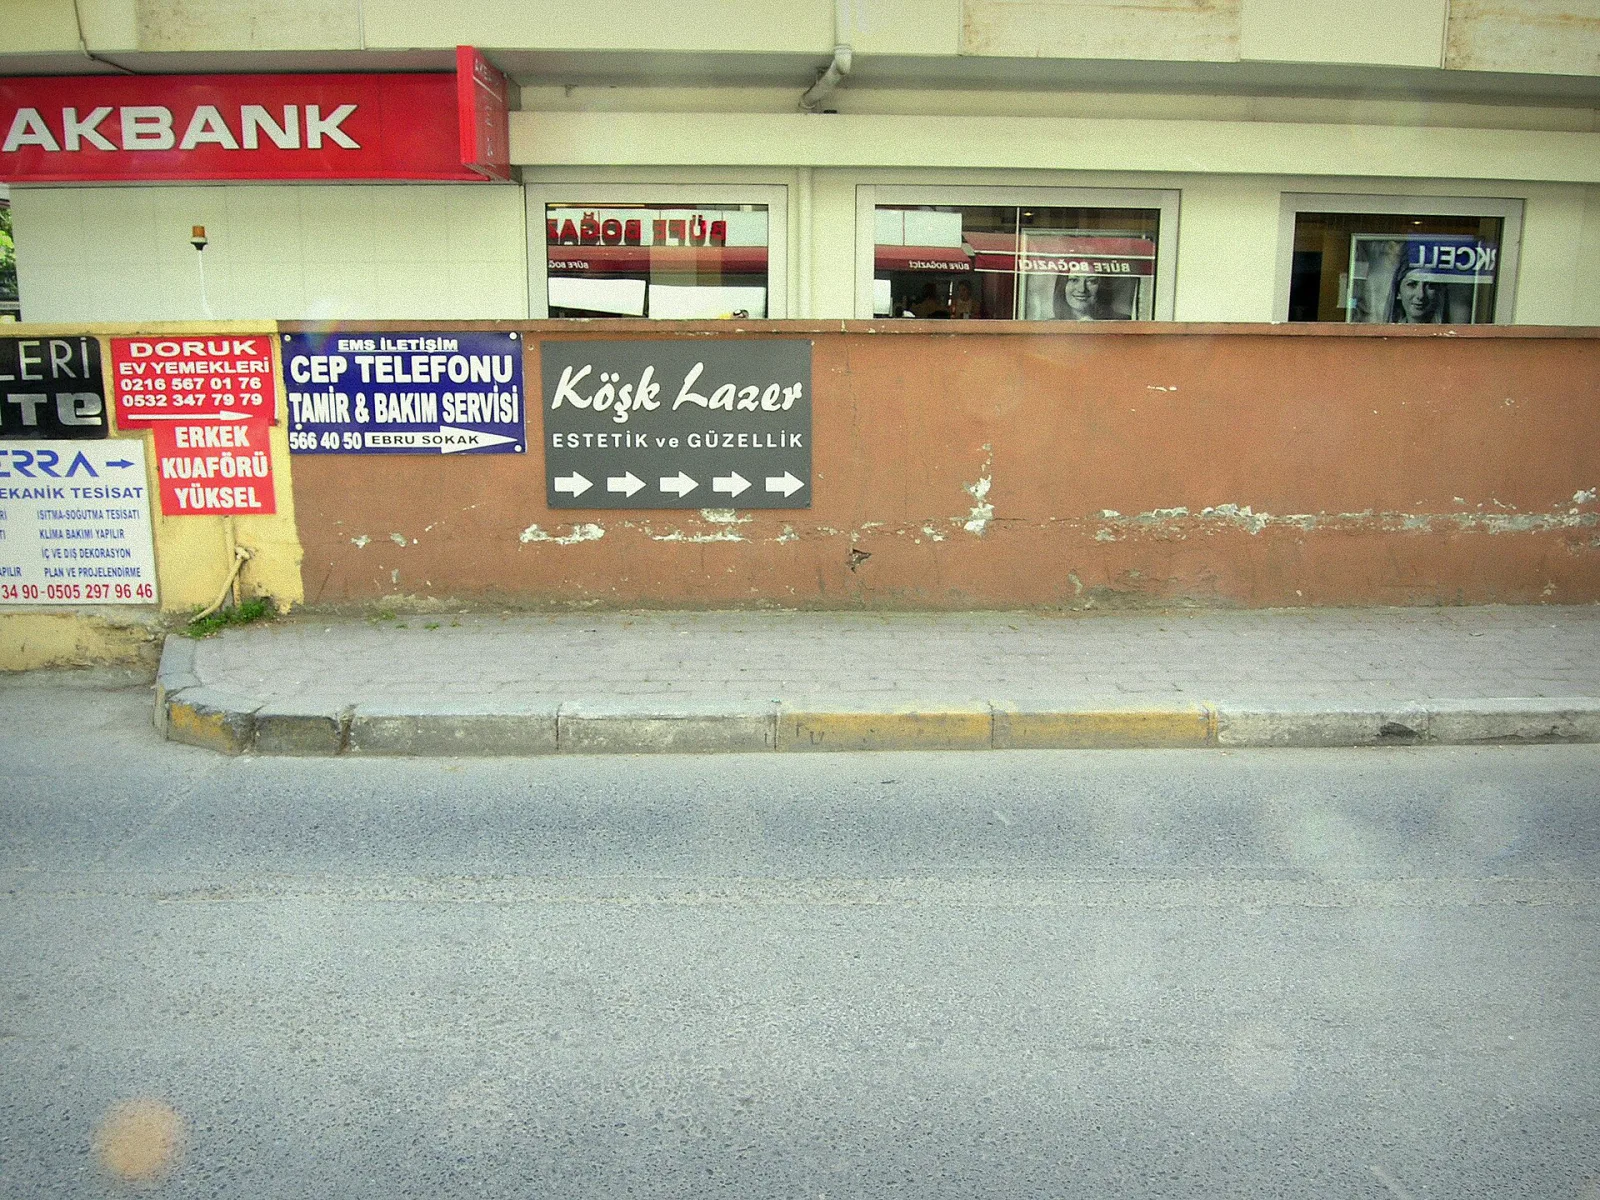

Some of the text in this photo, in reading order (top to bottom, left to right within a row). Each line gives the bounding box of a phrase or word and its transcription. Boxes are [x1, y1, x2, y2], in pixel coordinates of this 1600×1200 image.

[2, 104, 362, 152] AKBANK
[130, 340, 257, 357] DORUK
[338, 336, 459, 353] EMS İLETİŞİM
[119, 357, 269, 375] EV YEMEKLERİ
[290, 355, 513, 383] CEP TELEFONU
[120, 377, 262, 391] 0216 567 01 76
[551, 362, 803, 423] Köşk Lazer
[122, 393, 263, 407] 0532 347 79 79
[289, 384, 519, 424] TAMİR & BAKIM SERVİSİ
[174, 425, 250, 448] ERKEK
[289, 432, 363, 450] 566 40 50
[371, 435, 479, 445] EBRU SOKAK
[553, 430, 803, 448] ESTETİK ve GÜZELLİK
[161, 451, 269, 479] KUAFÖRÜ
[70, 485, 143, 499] TESİSAT
[174, 483, 262, 509] YÜKSEL
[40, 527, 125, 539] KLİMA BAKIMI YAPILIR
[51, 548, 62, 558] VE
[79, 548, 131, 558] DEKORASYON
[44, 566, 141, 577] PLAN VE PROJELENDİRME
[1, 584, 18, 599] 34
[85, 584, 110, 599] 297
[114, 584, 132, 599] 96
[136, 583, 153, 598] 46
